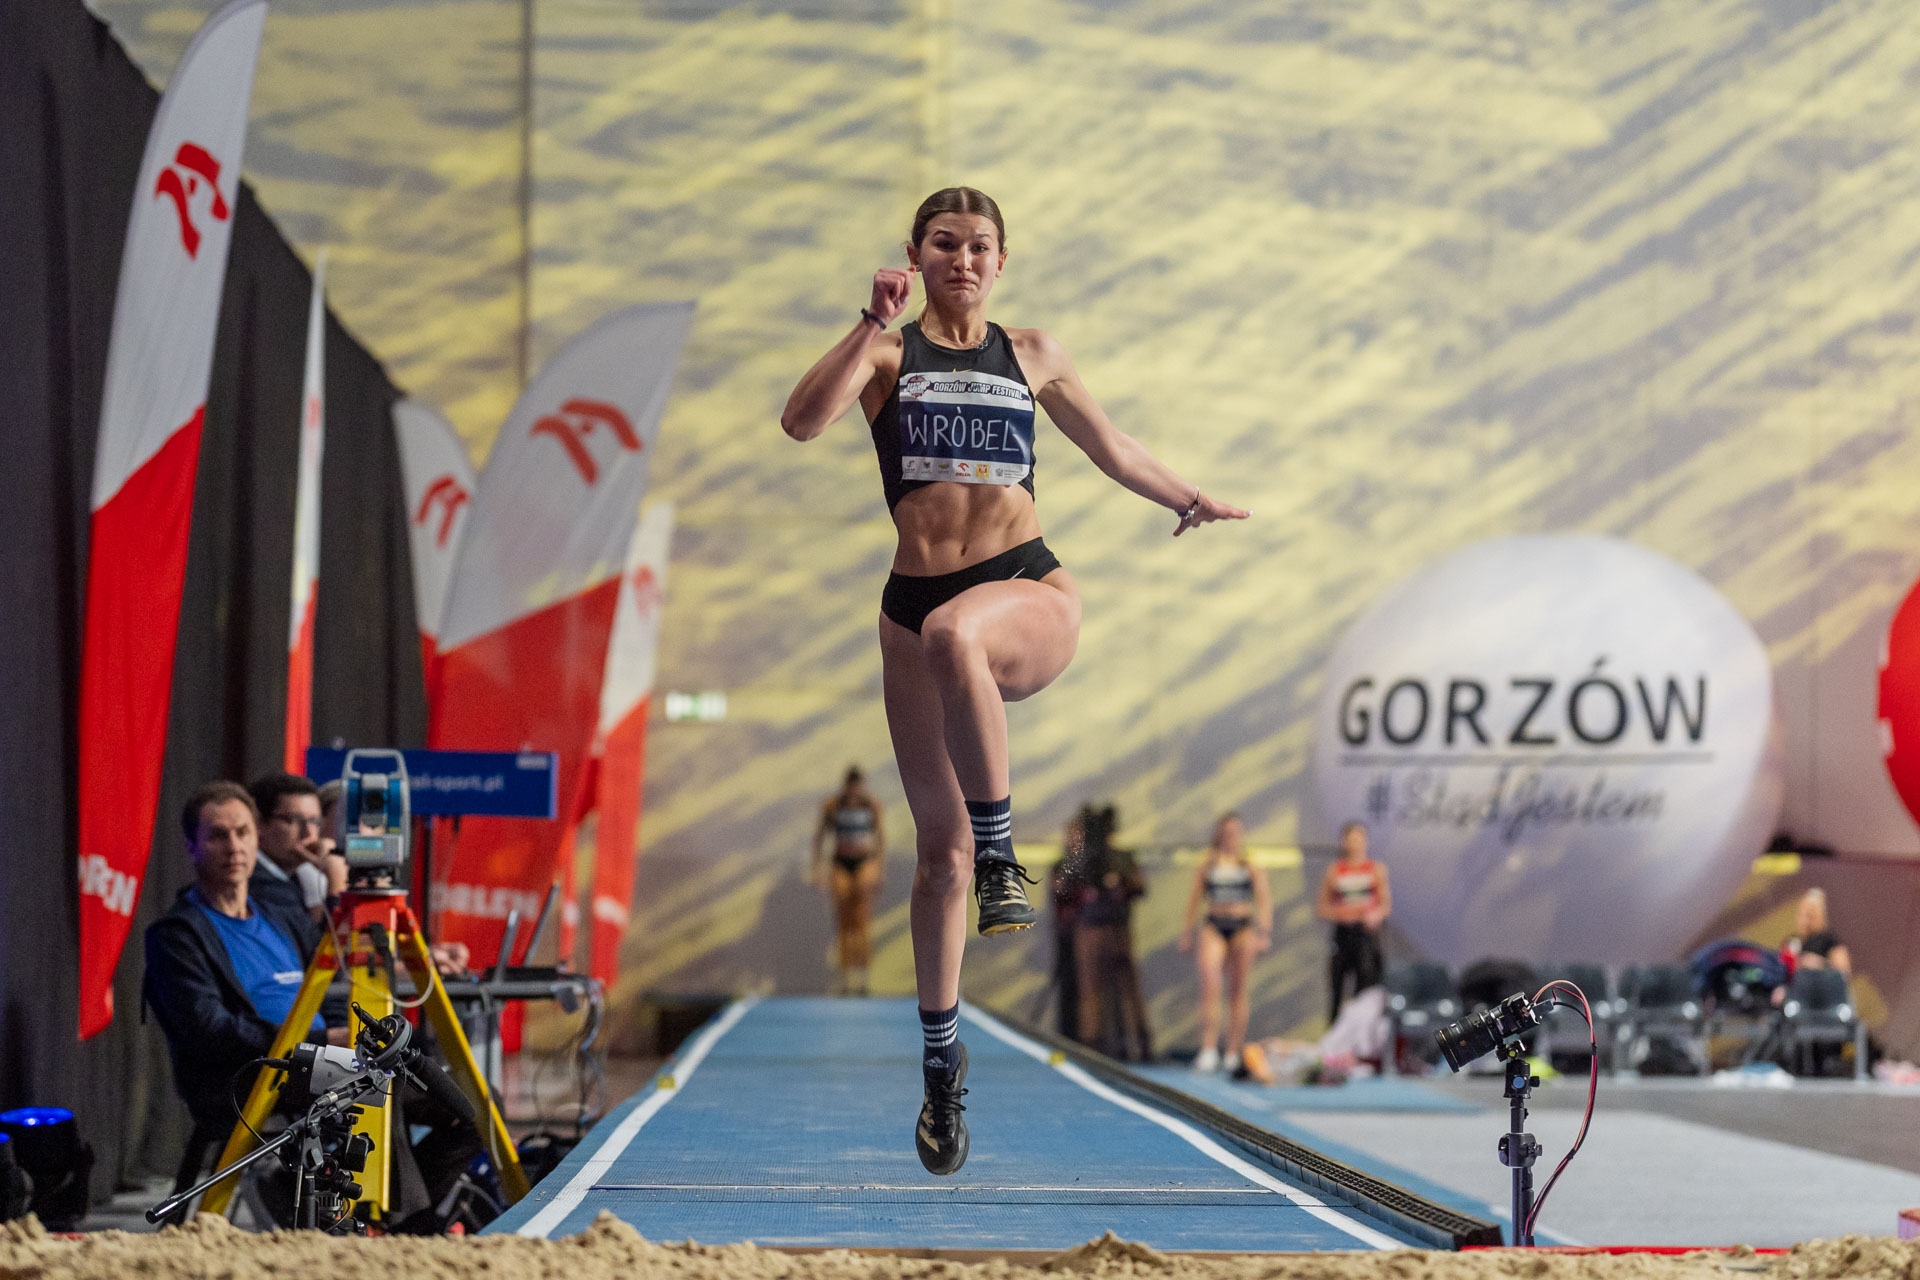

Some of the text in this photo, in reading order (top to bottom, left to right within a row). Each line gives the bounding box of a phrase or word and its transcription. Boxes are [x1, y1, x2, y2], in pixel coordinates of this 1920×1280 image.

[933, 380, 1024, 400] GORZÓW JUMP FESTIVAL
[1338, 656, 1708, 747] GORZÓW
